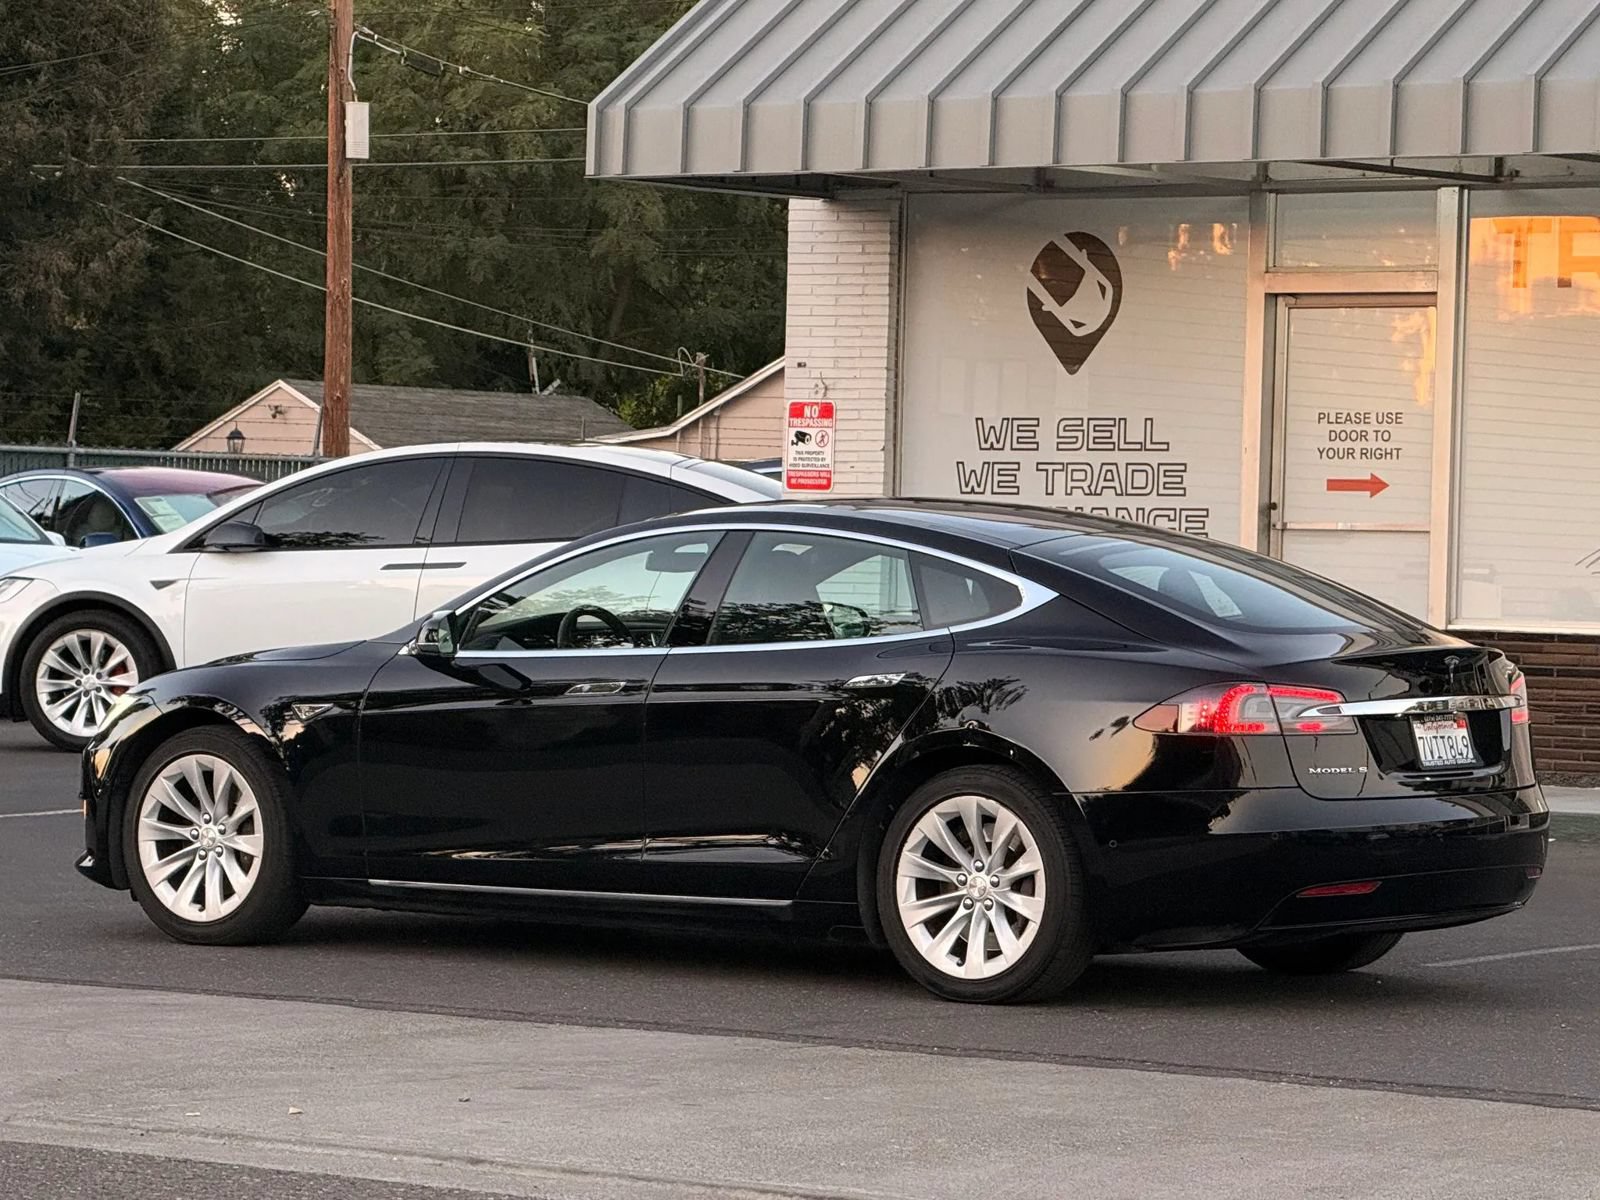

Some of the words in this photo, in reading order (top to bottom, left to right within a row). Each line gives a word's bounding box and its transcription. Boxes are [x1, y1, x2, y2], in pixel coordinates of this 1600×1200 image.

[803, 405, 819, 418] NO
[1317, 412, 1371, 424] PLEASE
[1375, 412, 1404, 424] USE
[789, 418, 833, 427] TRESPASSING
[975, 418, 1040, 451] WE
[1056, 418, 1170, 451] SELL
[1328, 430, 1369, 442] DOOR
[1373, 430, 1391, 442] TO
[1317, 447, 1356, 460] YOUR
[1359, 447, 1402, 460] RIGHT
[956, 461, 1021, 495] WE
[1036, 462, 1187, 496] TRADE
[1418, 735, 1469, 760] 7VIT849
